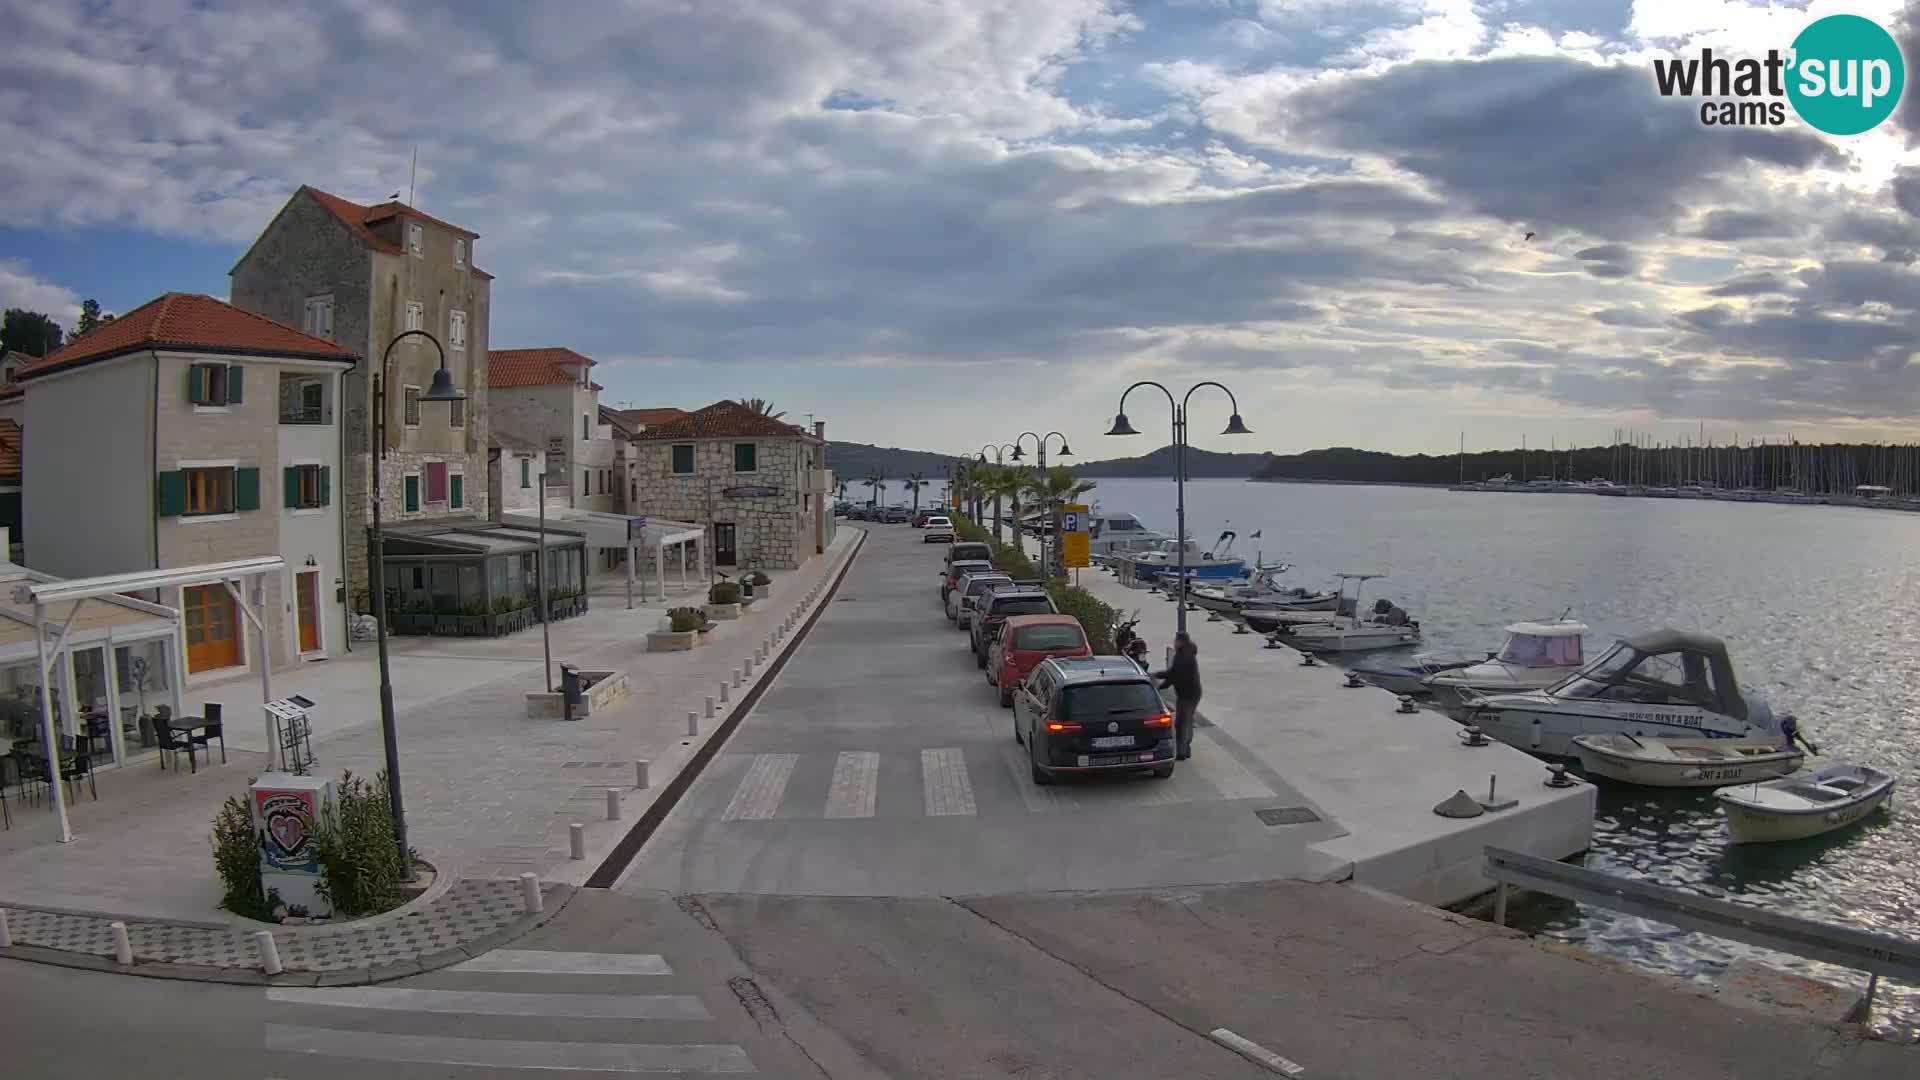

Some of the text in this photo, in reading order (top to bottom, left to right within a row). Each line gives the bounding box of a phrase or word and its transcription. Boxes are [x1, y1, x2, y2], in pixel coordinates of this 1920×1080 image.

[1065, 514, 1076, 530] P
[1655, 712, 1677, 725] RENT
[1684, 715, 1704, 728] BOAT
[1722, 768, 1743, 780] BOAT
